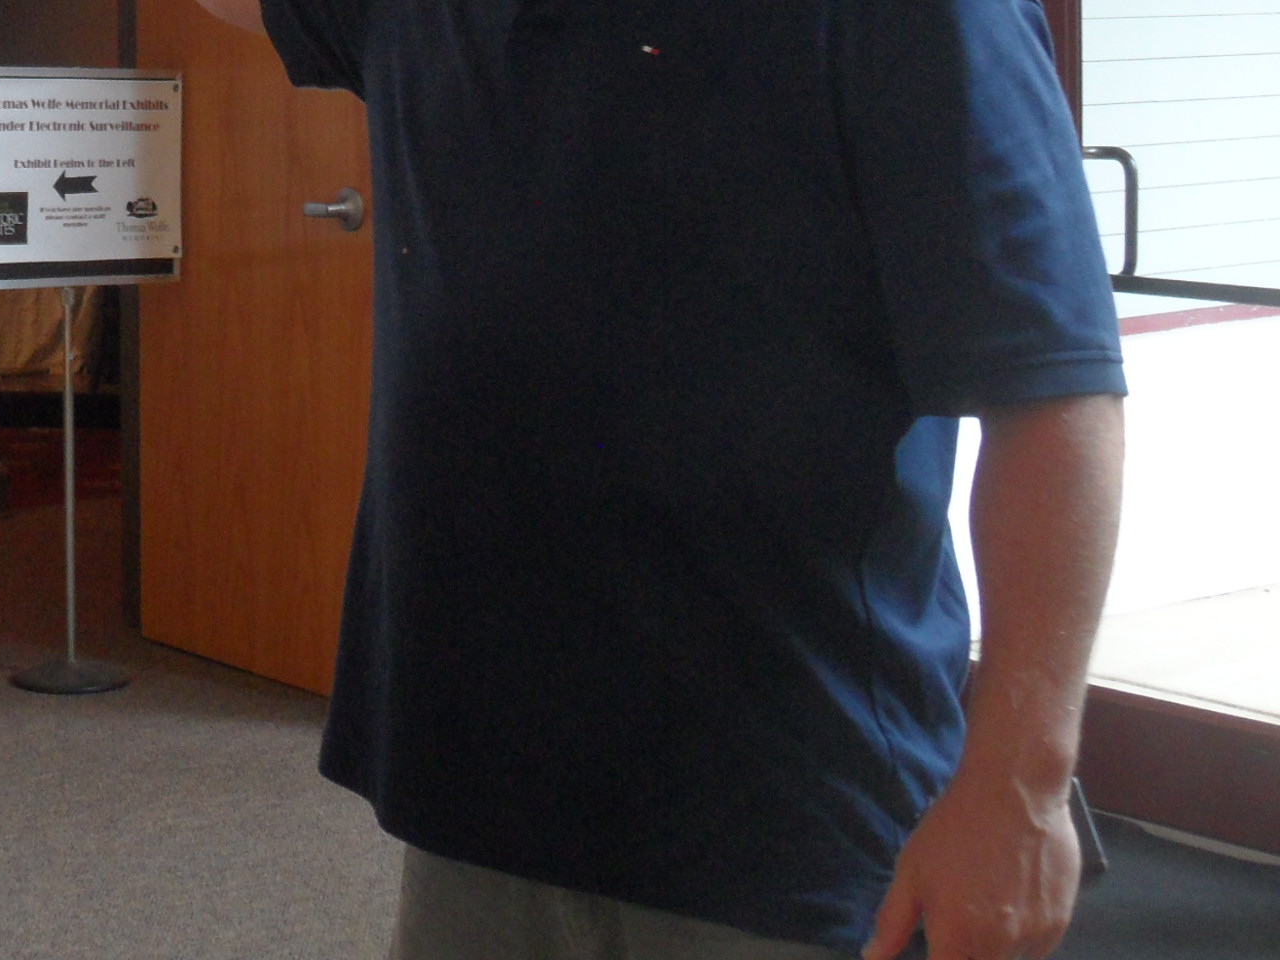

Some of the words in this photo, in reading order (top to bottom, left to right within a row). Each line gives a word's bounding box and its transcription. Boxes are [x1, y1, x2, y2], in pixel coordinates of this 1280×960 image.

[31, 98, 62, 110] Wolfe
[65, 99, 120, 111] Memorial
[122, 100, 169, 111] Exhibits
[28, 121, 85, 132] Electronic
[89, 120, 161, 132] Surveillance
[14, 159, 51, 169] Exhibit
[98, 159, 115, 169] the
[116, 158, 136, 168] Left
